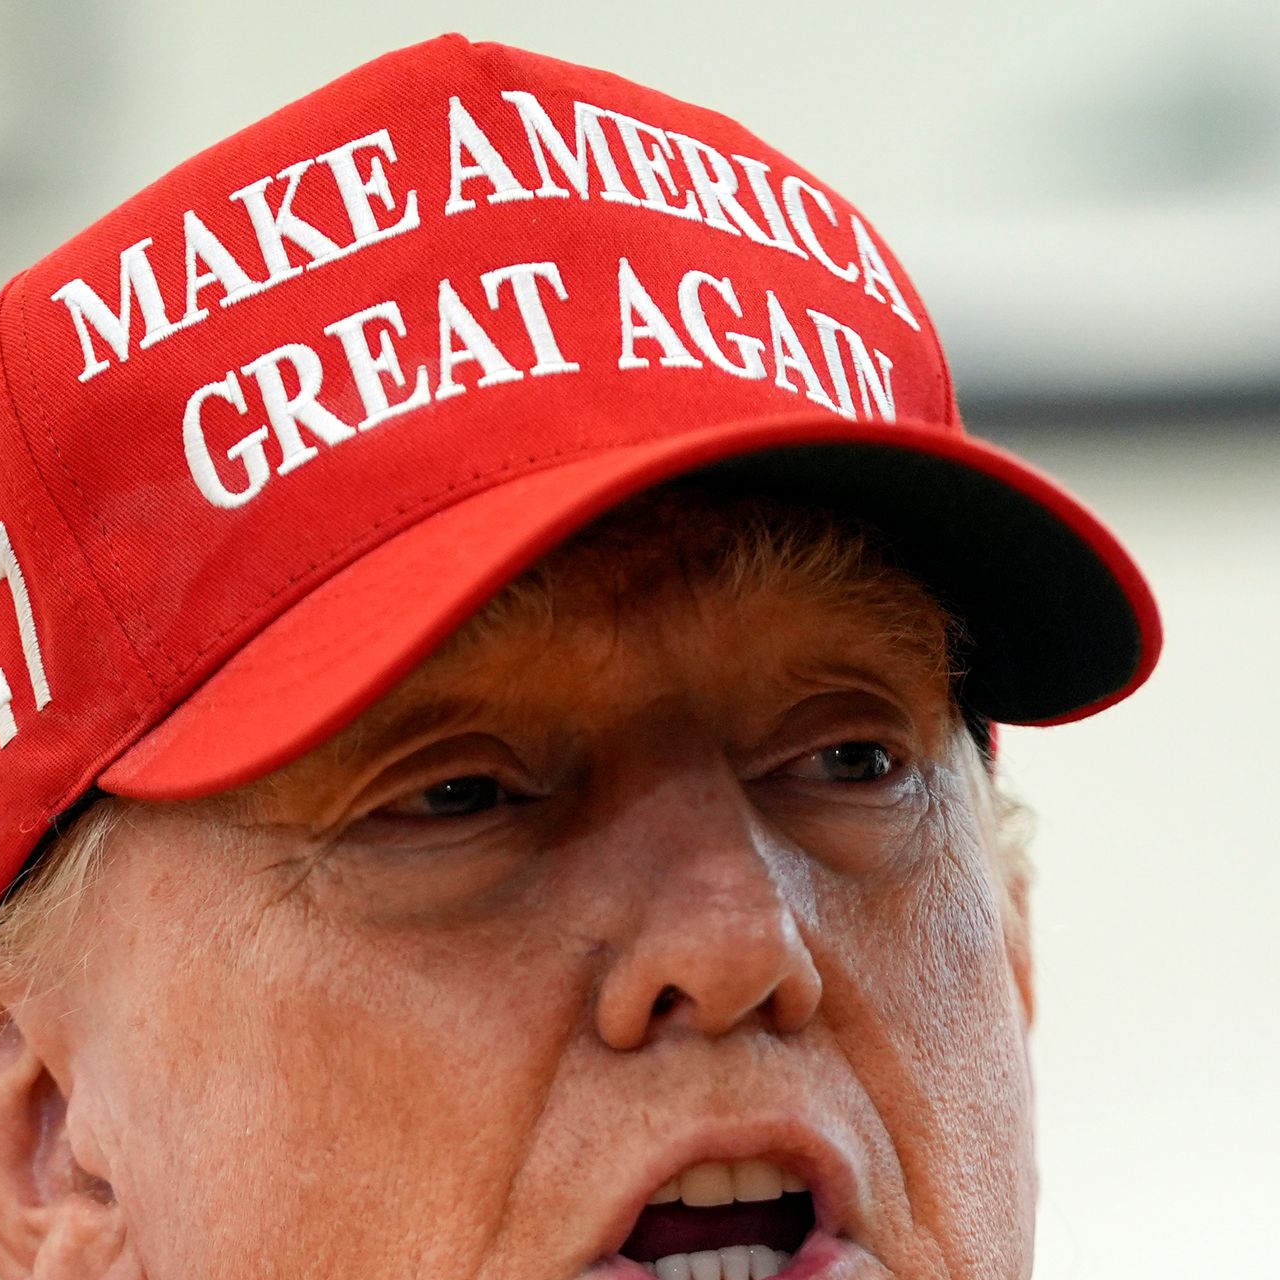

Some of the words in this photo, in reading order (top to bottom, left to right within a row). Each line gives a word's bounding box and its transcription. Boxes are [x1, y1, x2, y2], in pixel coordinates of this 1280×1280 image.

[50, 128, 419, 383] MAKE
[445, 90, 920, 332] AMERICA
[183, 260, 581, 512] GREAT
[617, 255, 897, 423] AGAIN
